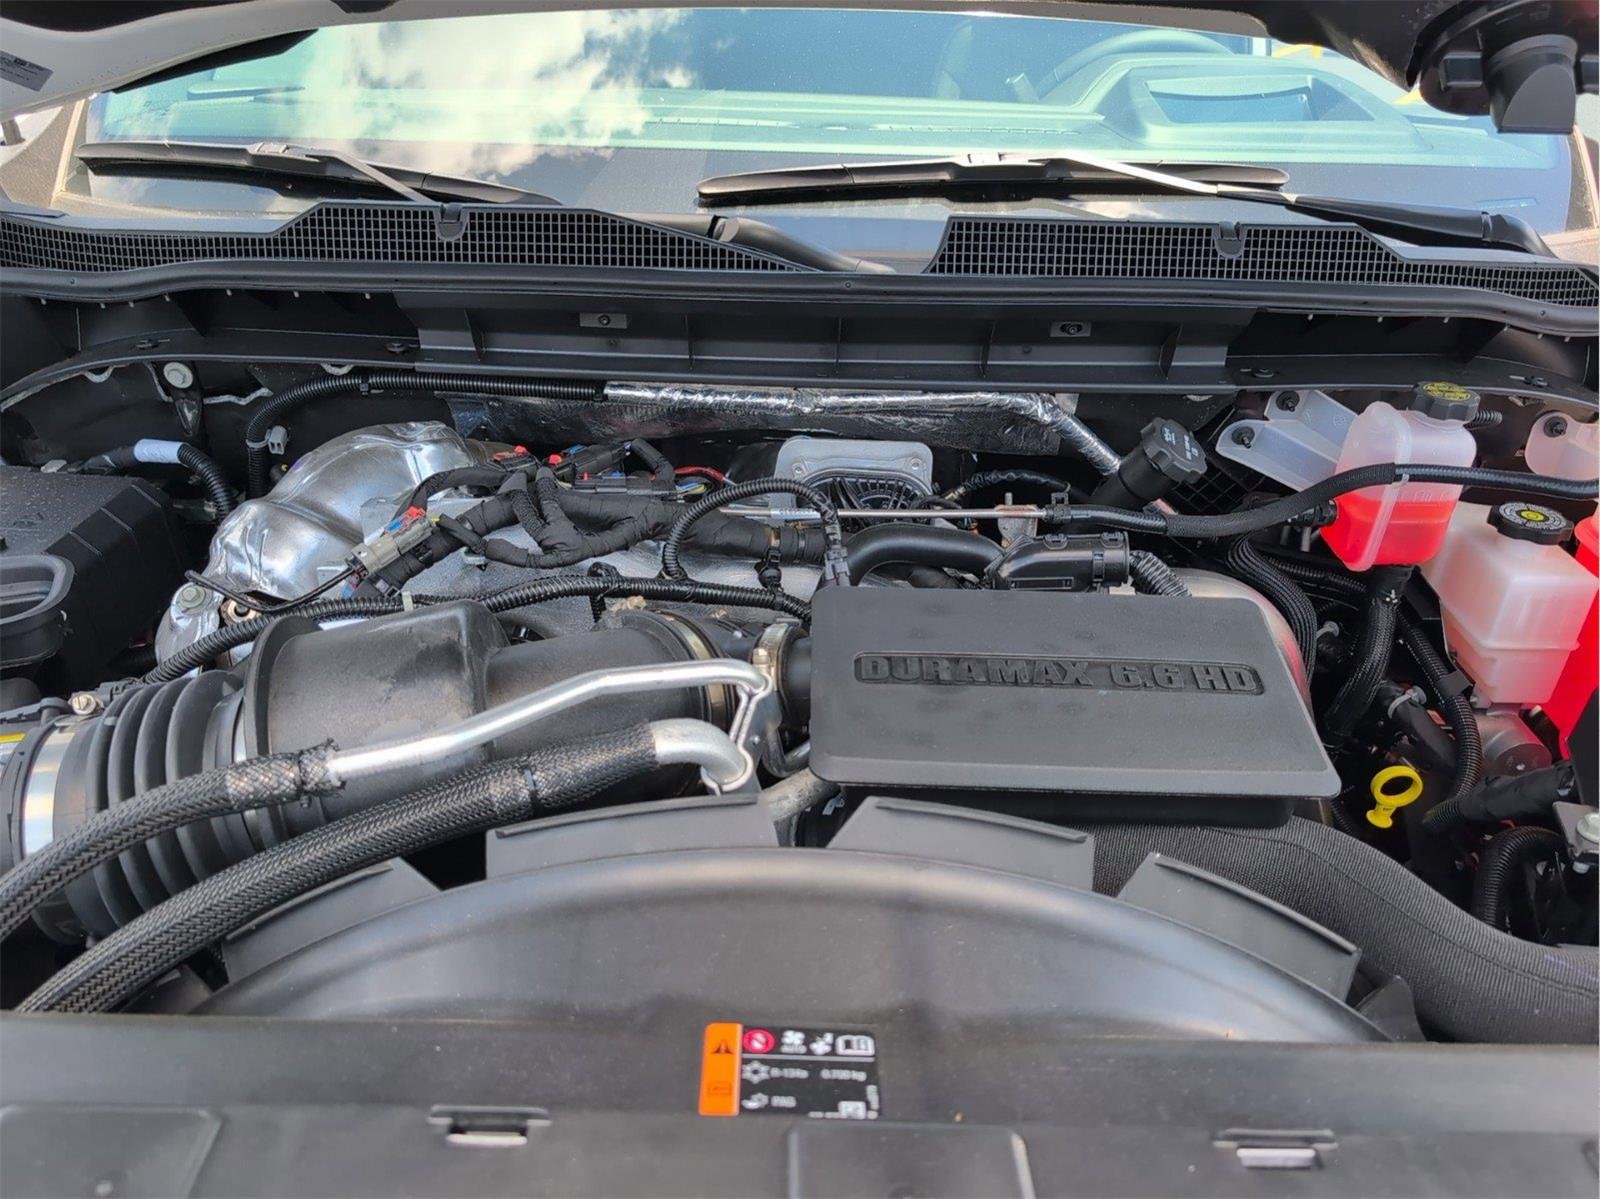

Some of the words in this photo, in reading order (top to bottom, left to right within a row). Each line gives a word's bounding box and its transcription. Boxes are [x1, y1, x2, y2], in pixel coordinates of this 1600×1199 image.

[860, 656, 1094, 687] DURAMAX
[1109, 663, 1185, 690] 6.6
[1194, 665, 1258, 692] HD
